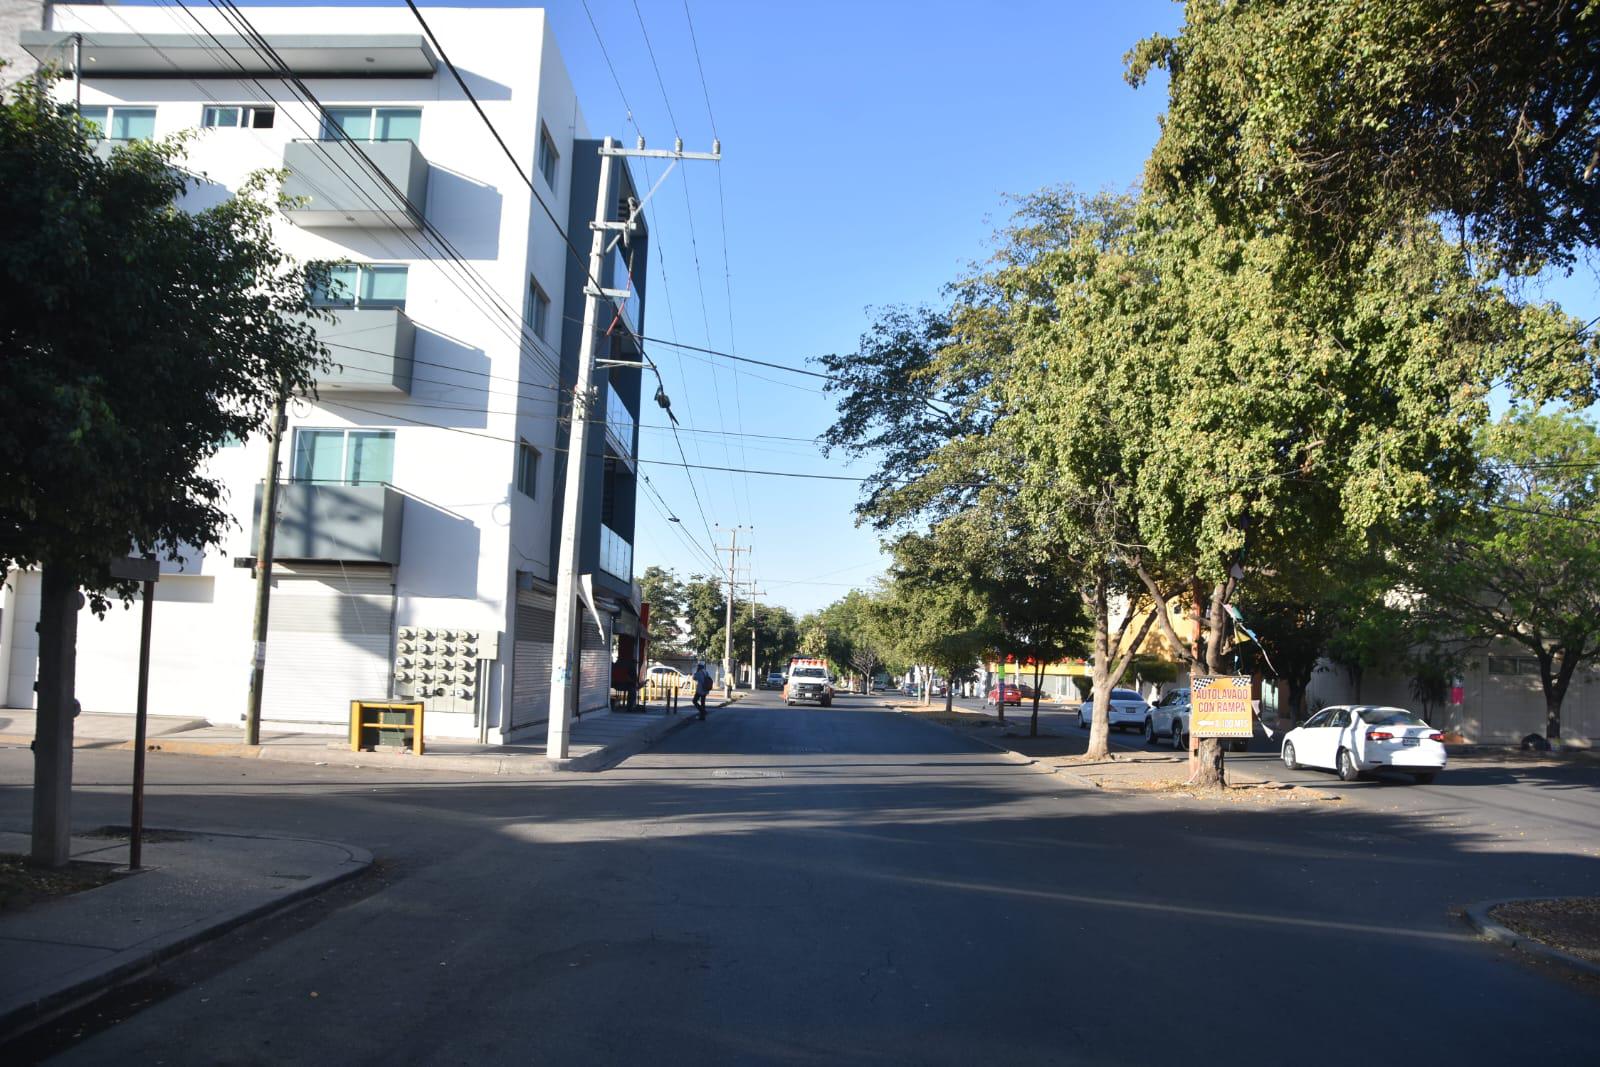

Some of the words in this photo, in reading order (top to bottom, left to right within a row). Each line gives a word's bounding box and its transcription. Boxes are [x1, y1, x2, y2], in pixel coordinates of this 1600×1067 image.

[1197, 689, 1248, 699] AUTOLAVADO
[1198, 702, 1214, 712] CON
[1217, 702, 1246, 712] RAMPA
